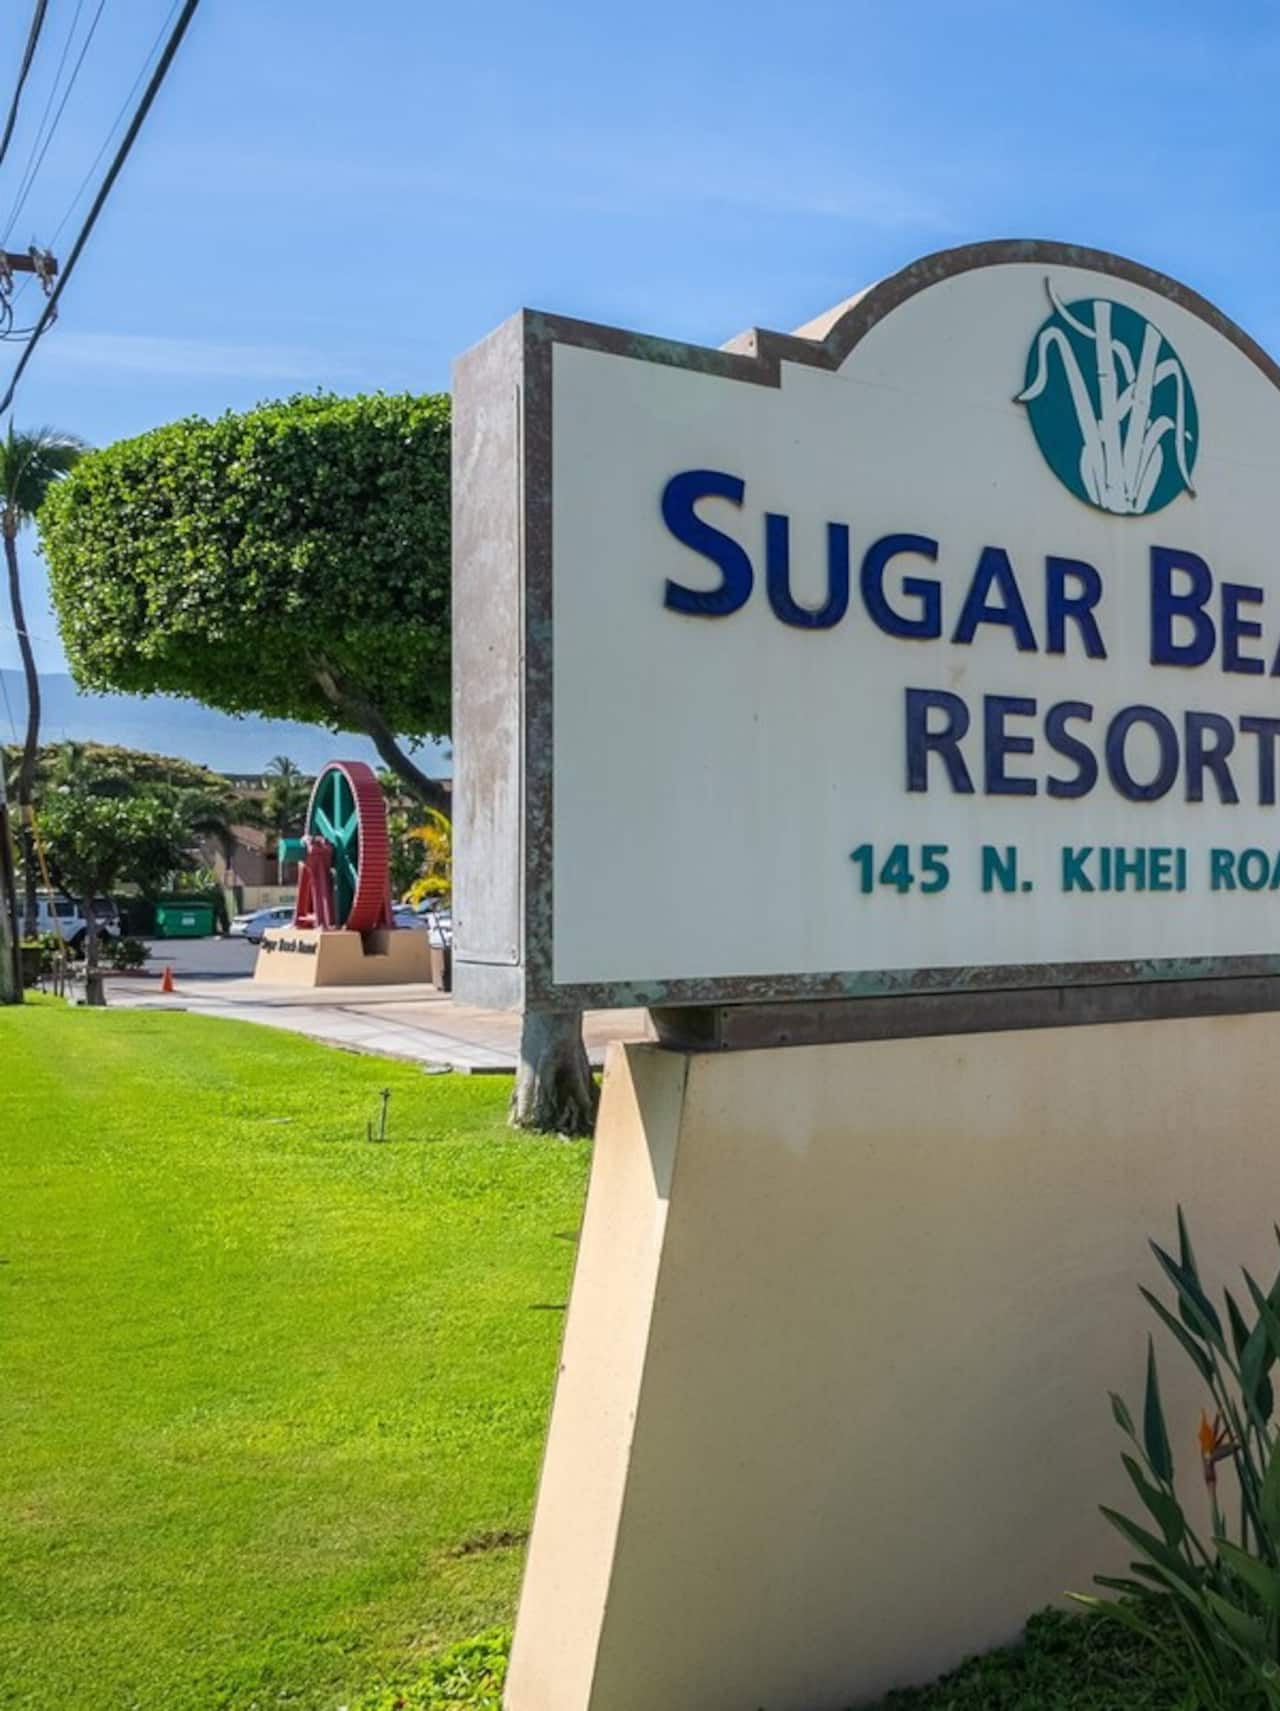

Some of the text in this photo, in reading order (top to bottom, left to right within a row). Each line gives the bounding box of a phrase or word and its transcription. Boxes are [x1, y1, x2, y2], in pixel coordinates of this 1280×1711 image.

[661, 469, 1107, 660] SUGAR
[849, 844, 950, 894] 145
[981, 845, 1033, 893] N.
[1061, 846, 1187, 893] KIHEI
